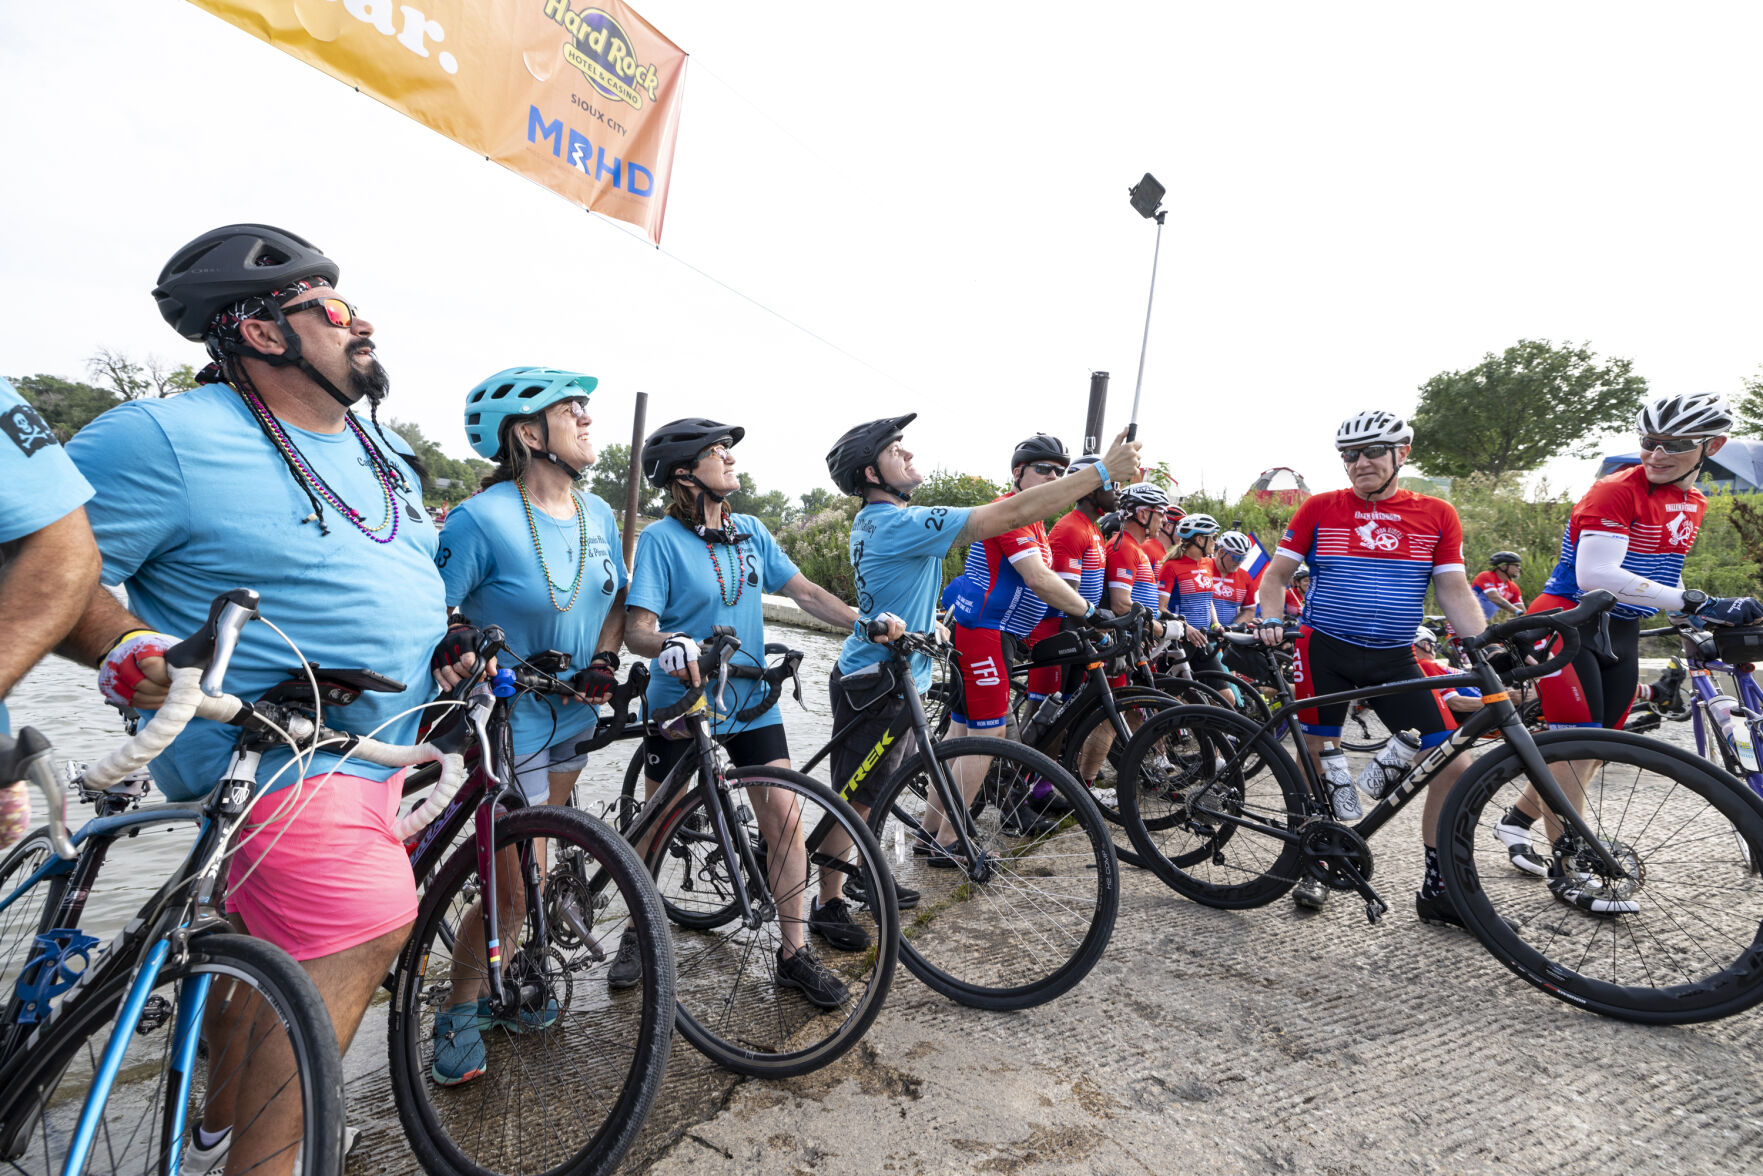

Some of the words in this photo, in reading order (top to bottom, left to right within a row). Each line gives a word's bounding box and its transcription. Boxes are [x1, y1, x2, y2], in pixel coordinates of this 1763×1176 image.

[330, 0, 458, 74] ar.
[544, 0, 608, 56] Hard
[607, 37, 659, 102] Rock
[568, 50, 597, 76] HOTEL
[599, 71, 605, 80] &
[607, 78, 638, 104] CASINO
[528, 104, 655, 198] MRHD
[571, 93, 604, 123] SIOUX
[607, 118, 628, 137] CITY
[925, 507, 948, 532] 23
[970, 656, 1000, 686] TFO
[840, 728, 895, 802] TREK
[1382, 726, 1471, 808] TREK
